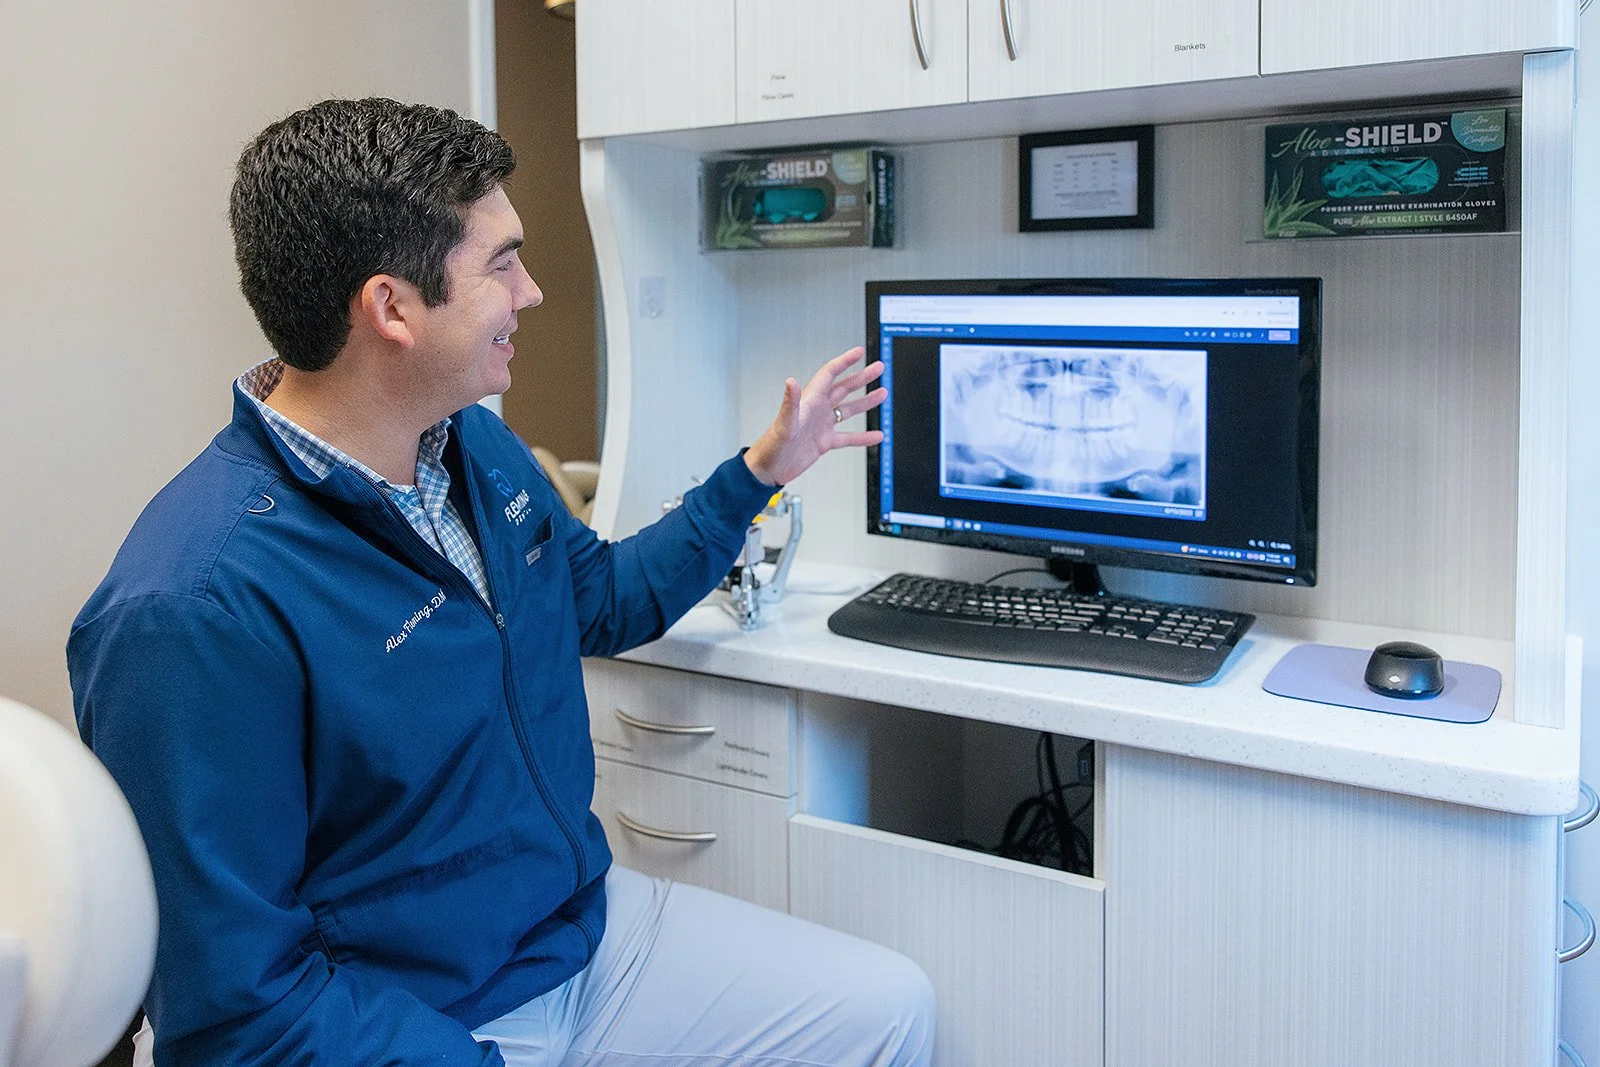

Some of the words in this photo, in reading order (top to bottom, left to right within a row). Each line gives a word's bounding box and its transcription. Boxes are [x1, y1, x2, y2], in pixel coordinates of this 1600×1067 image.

[1174, 43, 1206, 52] Blankets
[1320, 205, 1352, 213] POWDER
[1354, 204, 1373, 212] FREE
[1375, 203, 1406, 211] NITRILE
[1408, 201, 1463, 210] EXAMINATION
[1464, 199, 1497, 208] GLOVES
[1333, 217, 1354, 226] PURE
[1376, 214, 1413, 224] EXTRACT
[1419, 213, 1445, 223] STYLE
[1445, 212, 1478, 222] 6450AF
[385, 630, 408, 653] Alex
